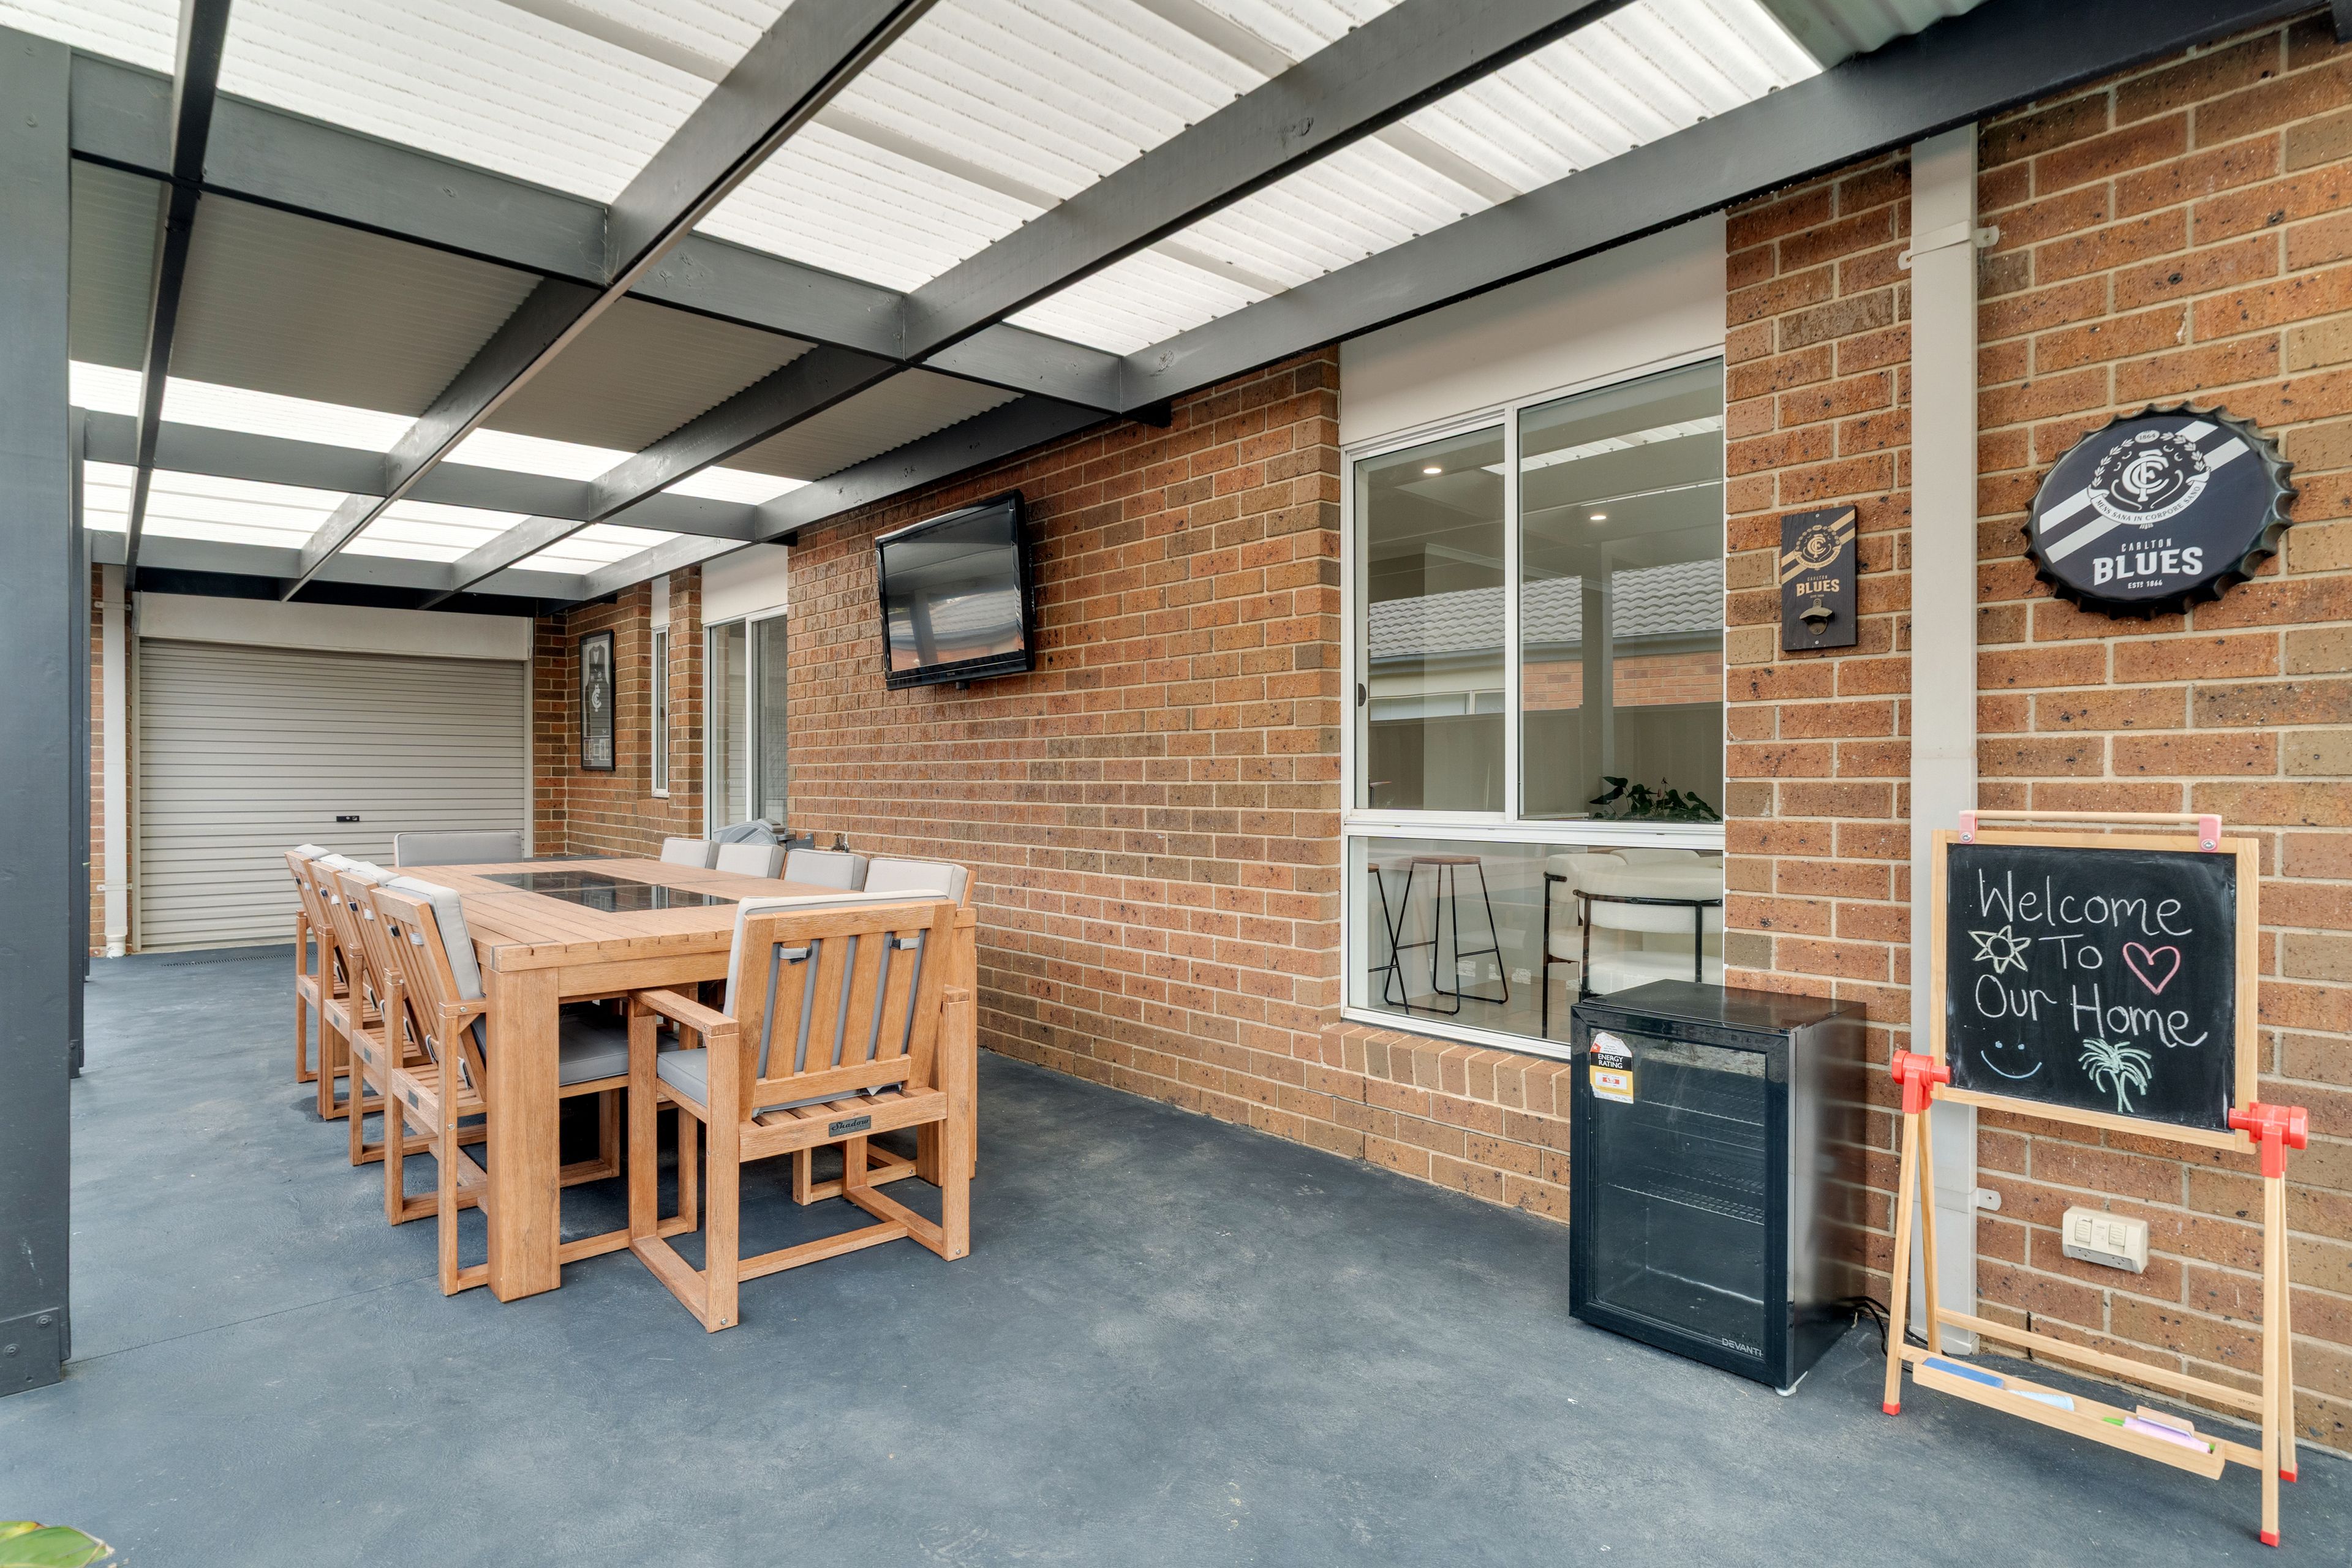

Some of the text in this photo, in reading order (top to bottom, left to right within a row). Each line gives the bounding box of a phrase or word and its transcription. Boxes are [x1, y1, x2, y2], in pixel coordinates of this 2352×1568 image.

[2095, 499, 2111, 514] MENS
[2111, 511, 2131, 521] SANA
[2145, 503, 2183, 521] CORPORE
[2184, 486, 2201, 507] SANO
[2121, 538, 2172, 552] CARLTON
[2092, 546, 2203, 586] BLUES
[1796, 579, 1840, 597] BLUES
[1978, 868, 2193, 937] Welcome
[2038, 933, 2103, 970] To
[1975, 974, 2209, 1048] Our Home
[1597, 1054, 1623, 1063] ENERGY
[1598, 1060, 1623, 1069] RATING
[831, 1119, 869, 1131] Shadow
[1722, 1337, 1762, 1357] DEVANTI
